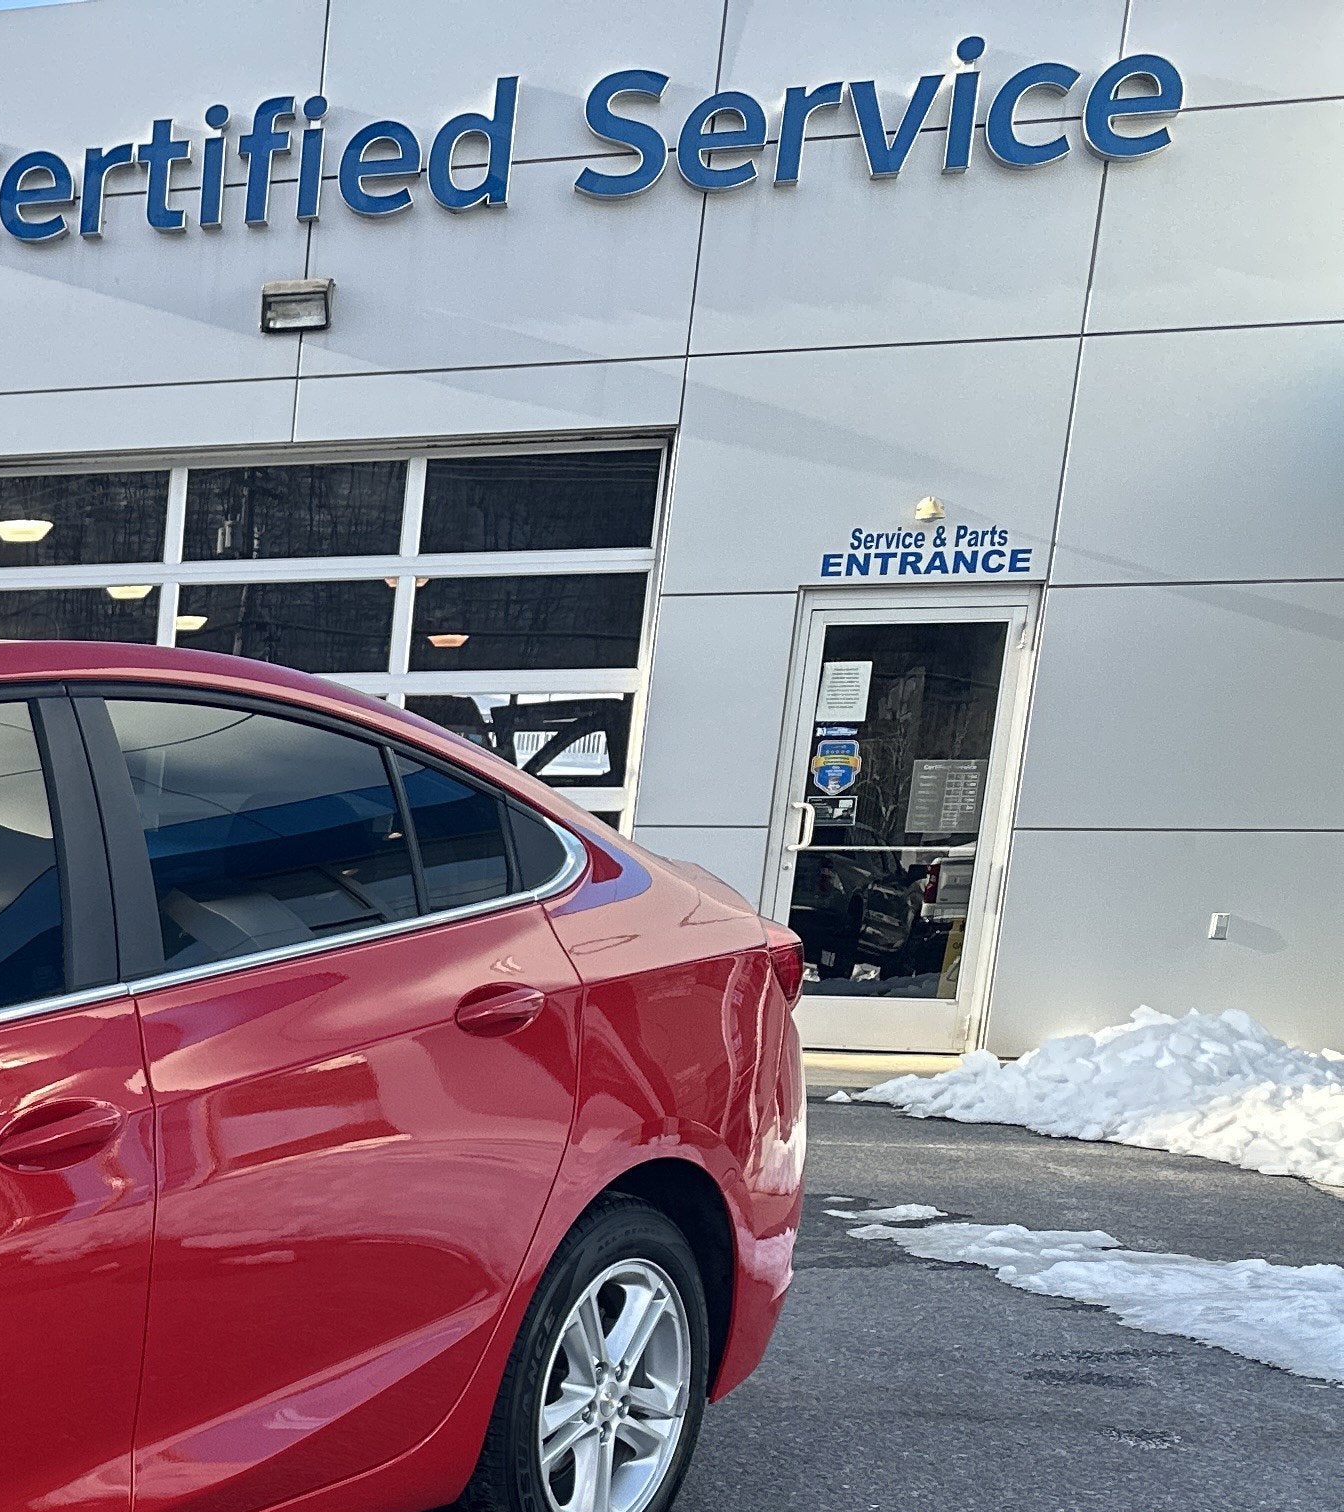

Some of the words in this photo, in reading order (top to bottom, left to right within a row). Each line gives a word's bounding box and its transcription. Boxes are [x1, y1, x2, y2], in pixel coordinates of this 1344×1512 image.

[574, 35, 1184, 201] Service
[849, 527, 926, 550] Service
[933, 525, 947, 548] &
[955, 525, 1009, 548] Parts
[820, 548, 1033, 577] ENTRANCE
